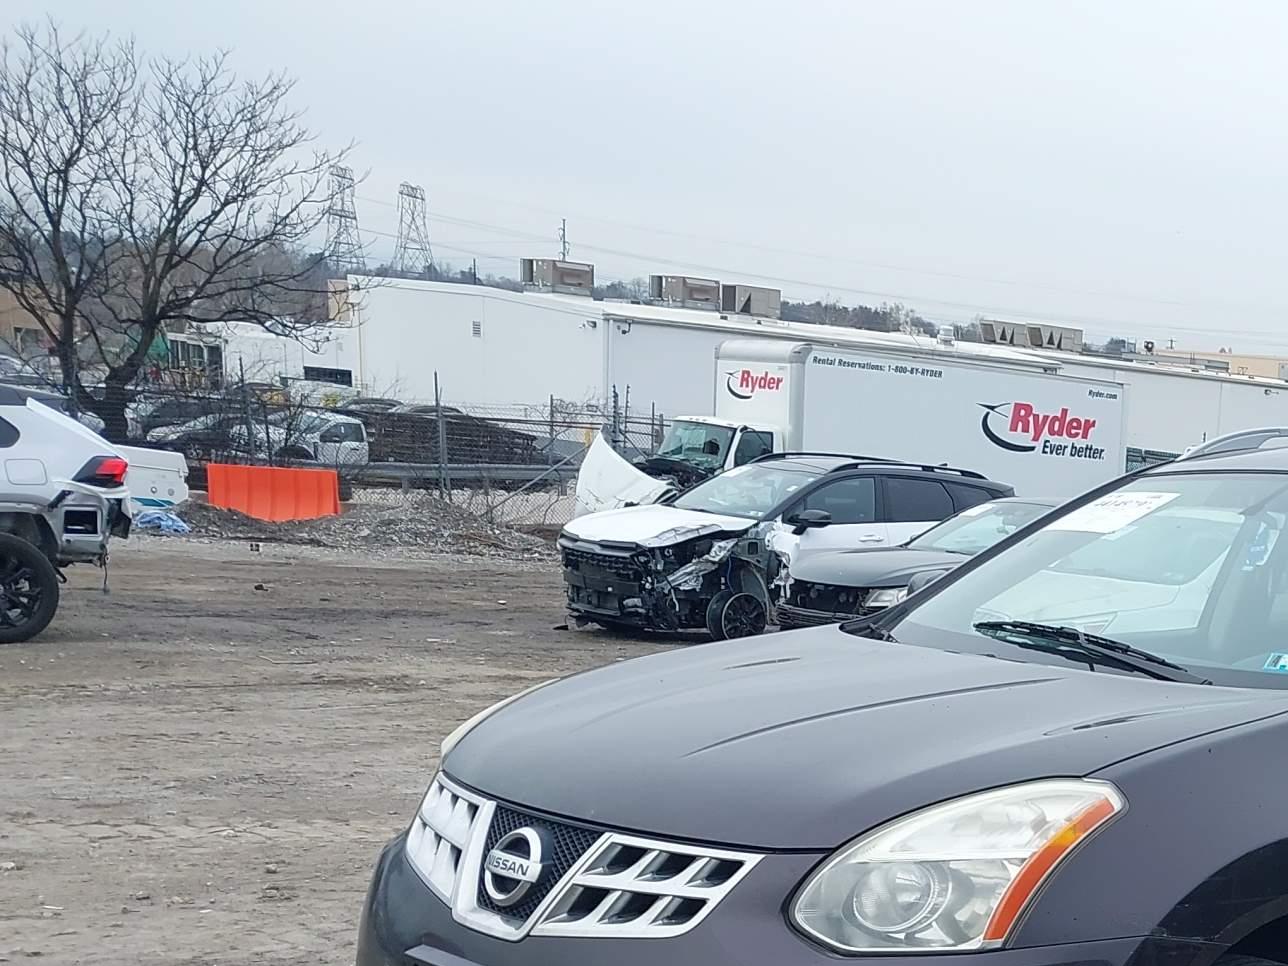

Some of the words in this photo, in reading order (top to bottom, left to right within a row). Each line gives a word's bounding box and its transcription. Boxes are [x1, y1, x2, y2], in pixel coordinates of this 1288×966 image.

[812, 356, 837, 366] Rental
[837, 358, 886, 372] Reservations:
[739, 370, 784, 393] Ryder
[1088, 389, 1118, 400] Ryder.com
[1009, 402, 1096, 442] Ryder
[1041, 440, 1068, 457] Ever
[1069, 442, 1105, 461] better.
[488, 854, 530, 876] NISSAN
